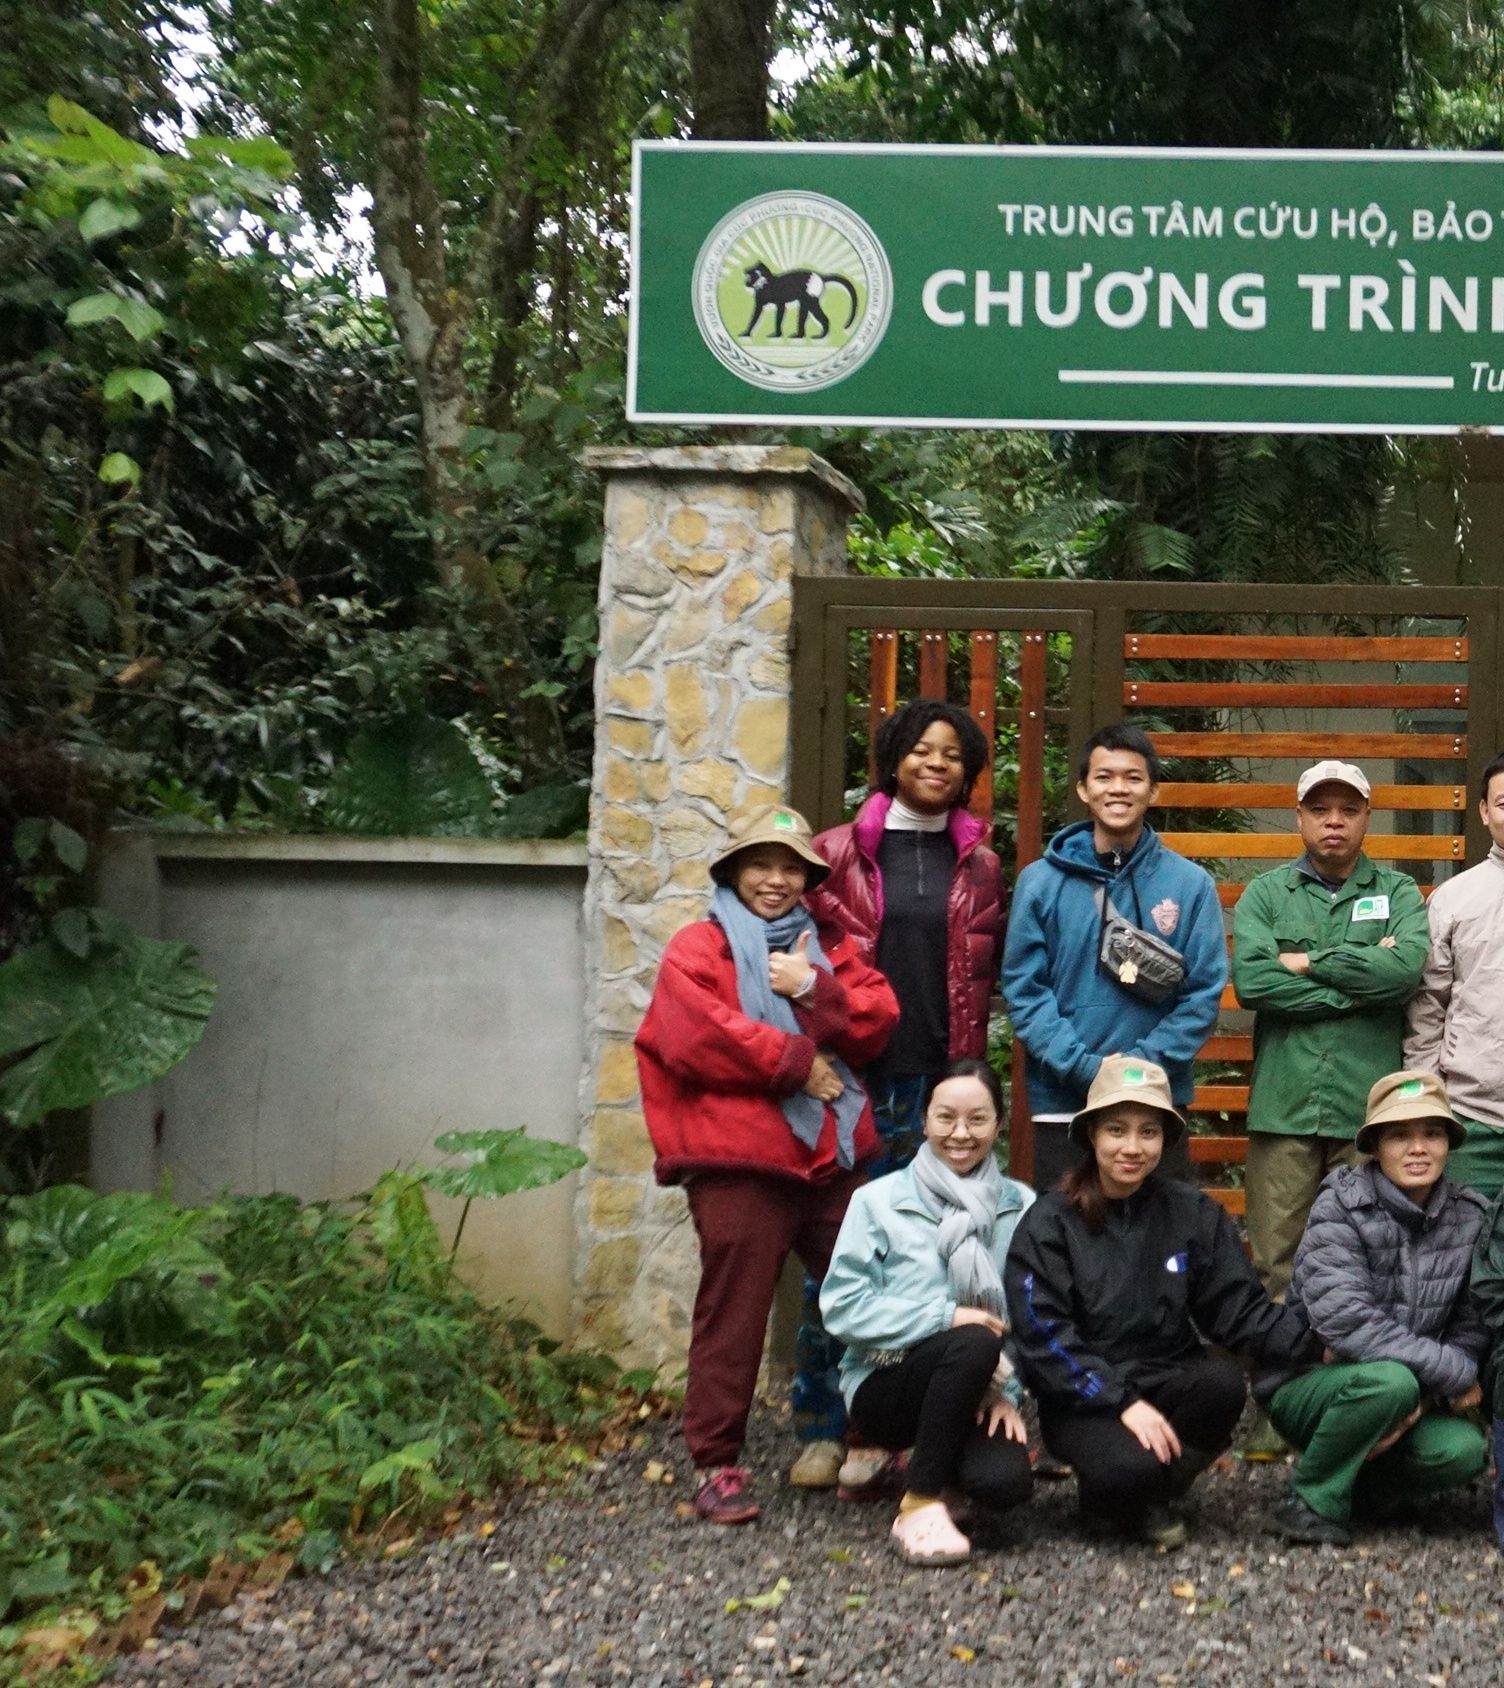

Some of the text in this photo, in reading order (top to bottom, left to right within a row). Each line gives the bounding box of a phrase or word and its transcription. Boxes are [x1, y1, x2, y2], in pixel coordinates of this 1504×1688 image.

[997, 203, 1134, 237] TRUNG
[1141, 200, 1224, 238] TÂM
[1233, 201, 1318, 239] CỨU
[1330, 202, 1398, 248] HỘ,
[1412, 200, 1493, 241] BẢO
[921, 262, 1267, 331] CHƯƠNG
